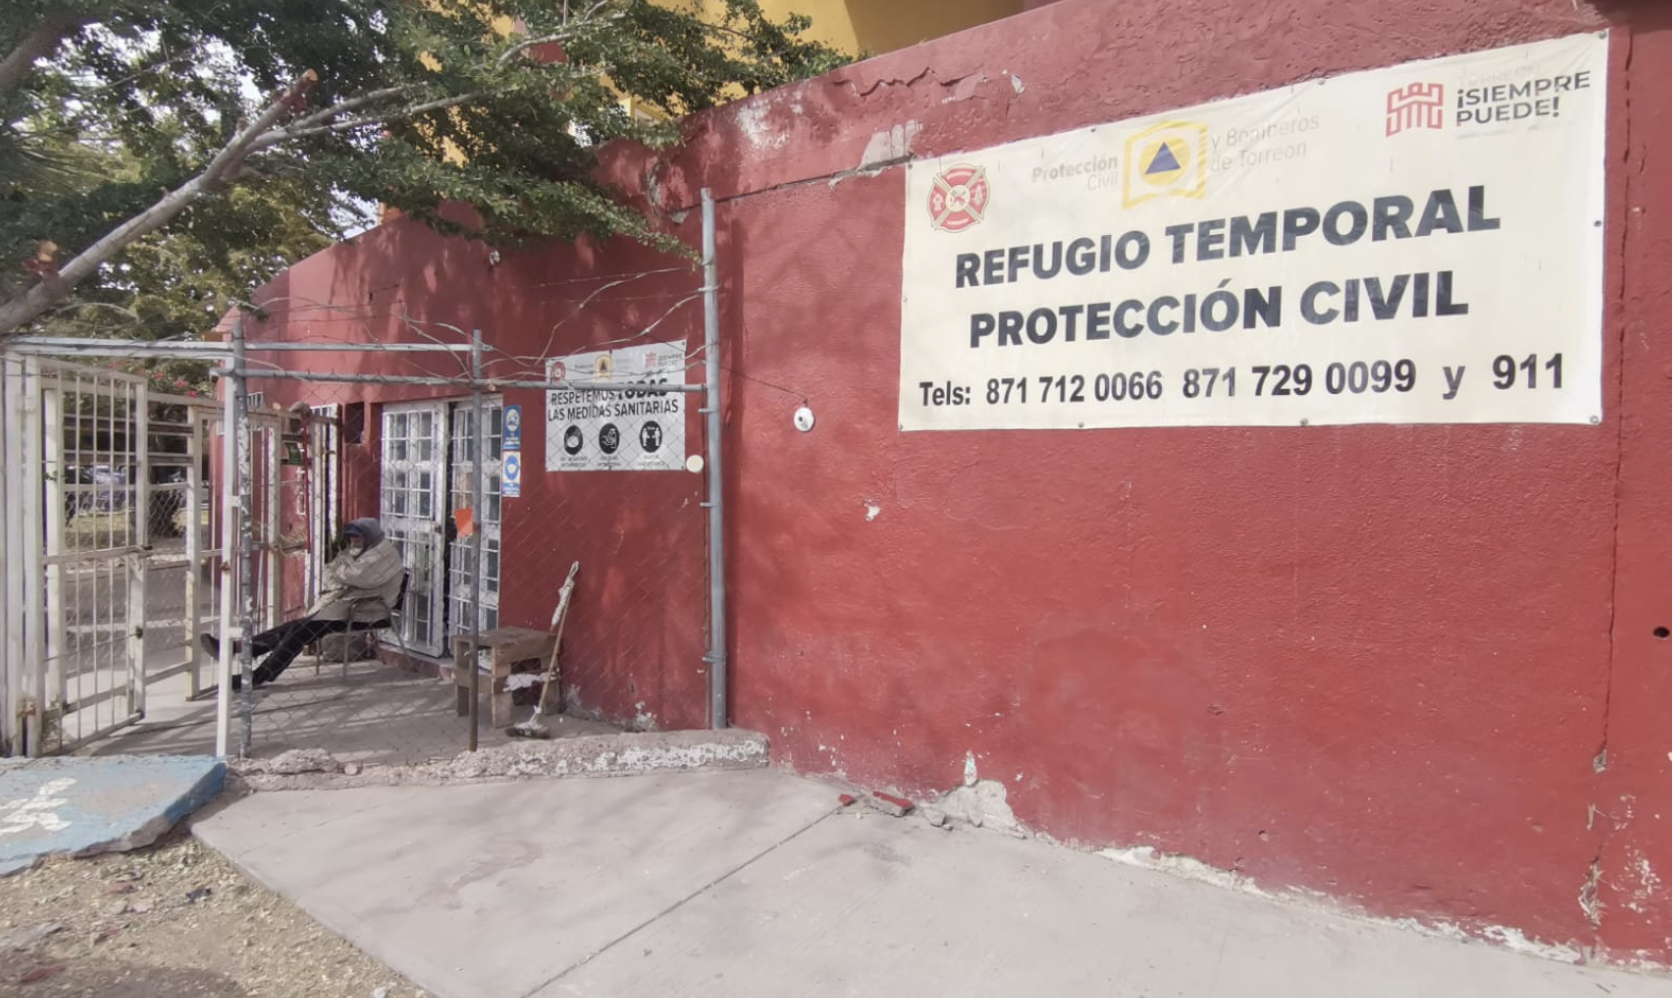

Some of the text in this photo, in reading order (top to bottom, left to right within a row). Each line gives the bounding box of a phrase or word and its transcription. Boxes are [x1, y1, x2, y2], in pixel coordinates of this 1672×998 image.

[1457, 70, 1592, 109] ¡SIEMPRE
[1457, 96, 1560, 127] PUEDE!
[1032, 154, 1118, 183] Protección
[1211, 154, 1232, 171] de
[1086, 173, 1118, 192] Civil
[956, 185, 1500, 288] REFUGIO TEMPORAL
[970, 270, 1469, 348] PROTECCIÓN CIVIL
[919, 353, 1563, 407] Tels: 871 712 0066 871 729 0099 y 911
[548, 399, 679, 421] LAS MEDIDAS SANITARIAS
